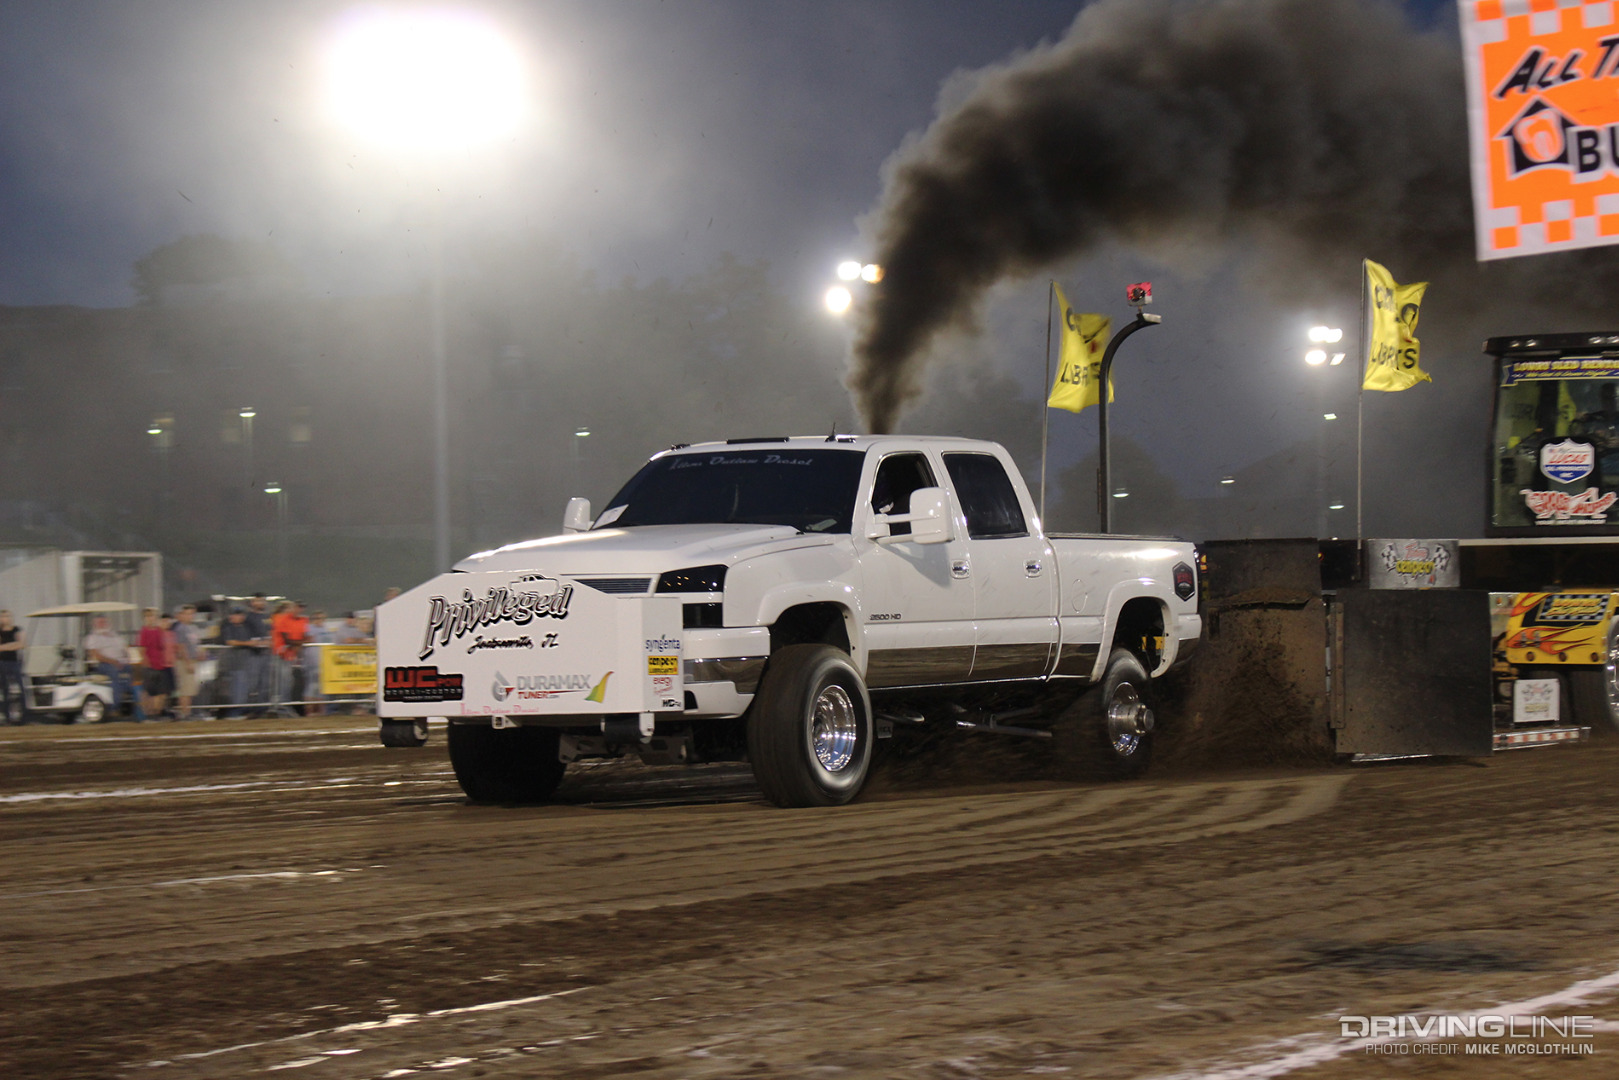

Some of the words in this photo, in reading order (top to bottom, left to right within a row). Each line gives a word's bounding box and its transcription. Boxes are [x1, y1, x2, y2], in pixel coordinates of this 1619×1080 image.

[764, 454, 813, 466] Diesel
[1548, 454, 1590, 464] LUCAS
[418, 584, 573, 661] Privileged
[645, 637, 680, 653] syngenta
[516, 674, 592, 691] DURAMAX
